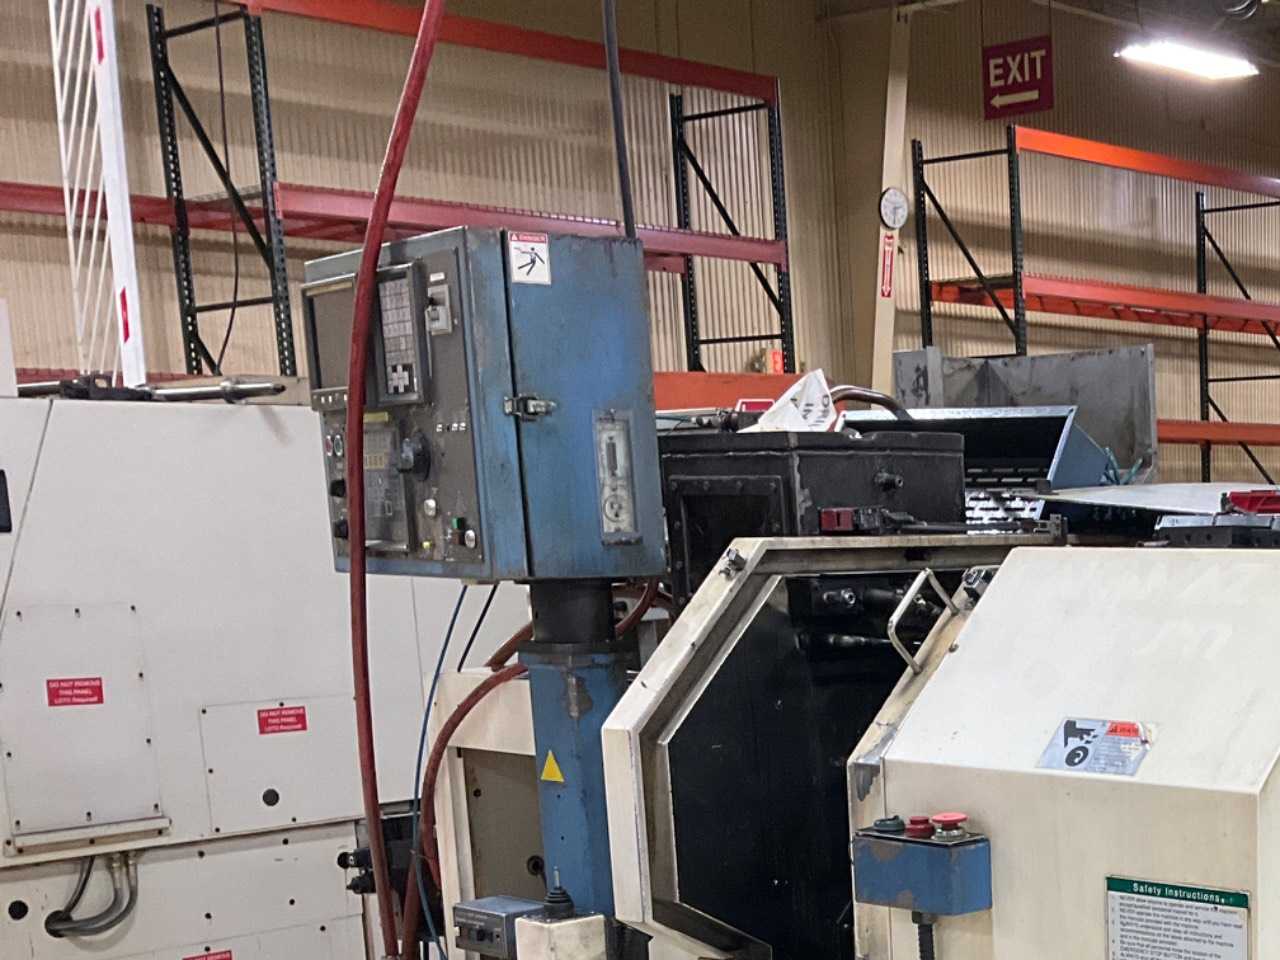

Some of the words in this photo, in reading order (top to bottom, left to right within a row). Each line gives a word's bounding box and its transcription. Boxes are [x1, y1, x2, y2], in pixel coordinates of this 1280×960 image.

[989, 49, 1046, 87] EXIT
[1132, 882, 1161, 896] Safety
[1165, 887, 1220, 903] Instructions
